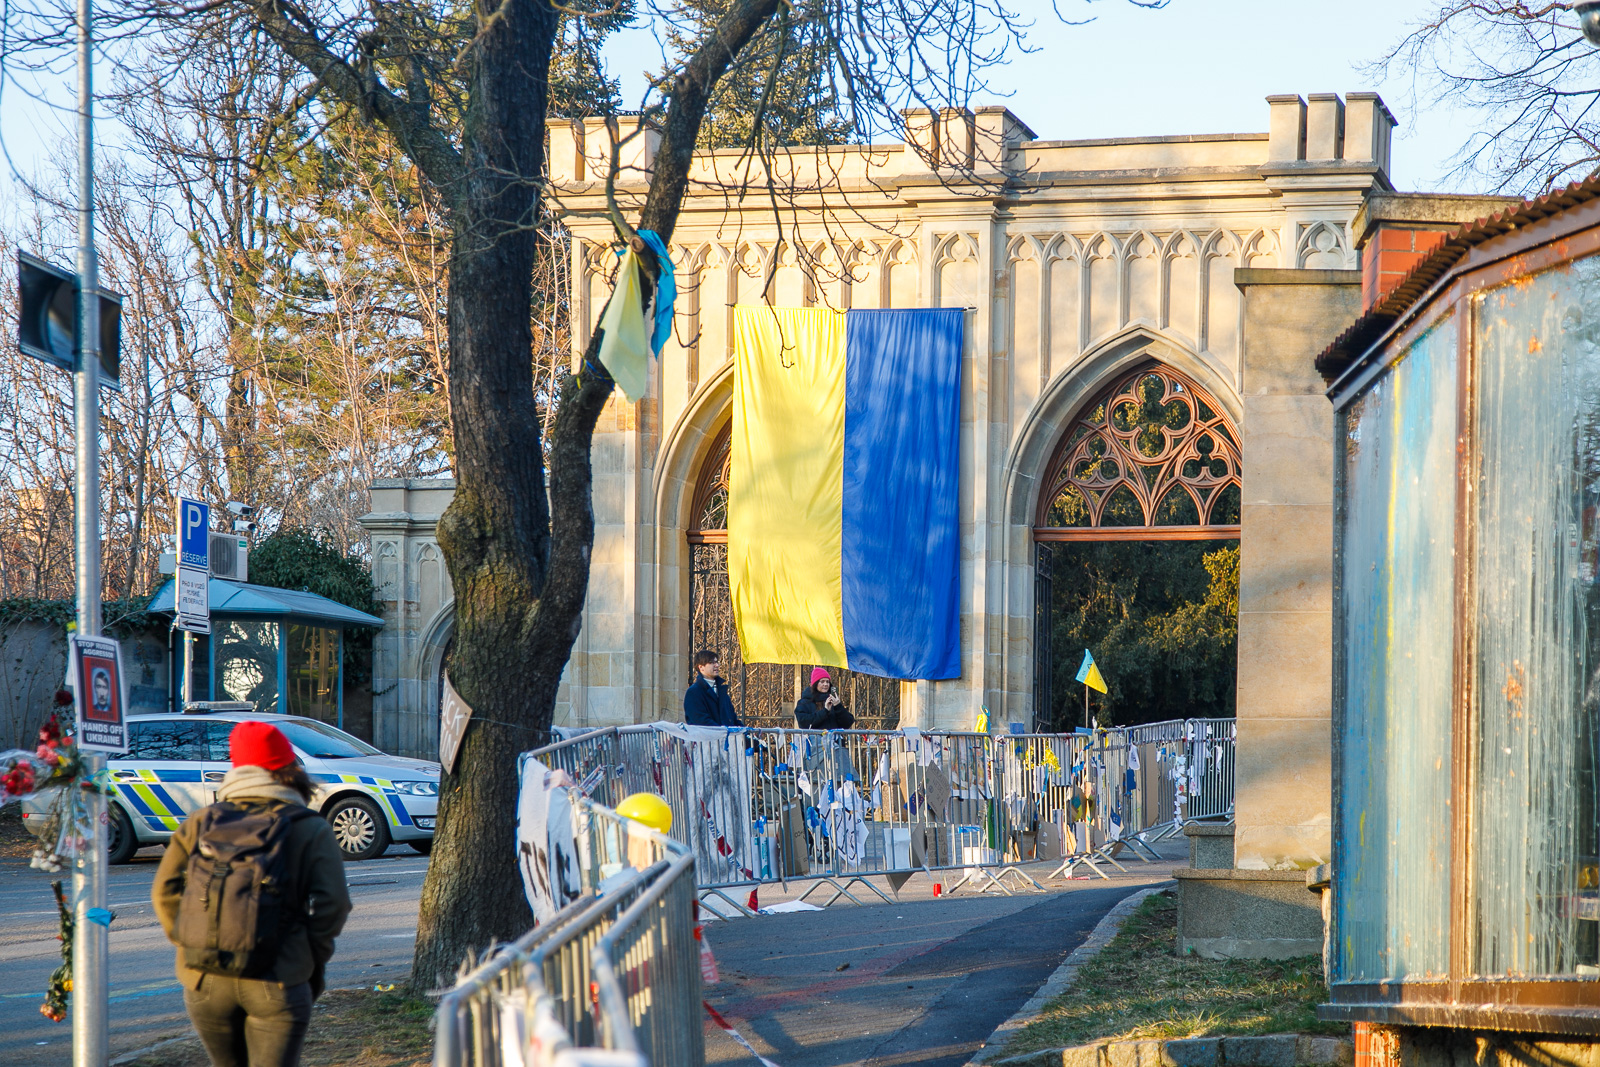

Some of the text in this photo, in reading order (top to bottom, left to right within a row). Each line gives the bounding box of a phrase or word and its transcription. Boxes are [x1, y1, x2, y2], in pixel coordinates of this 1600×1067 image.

[187, 504, 202, 540] P
[77, 640, 95, 648] STOP
[81, 722, 123, 735] HANDS OFF
[86, 733, 120, 745] UKRAINE
